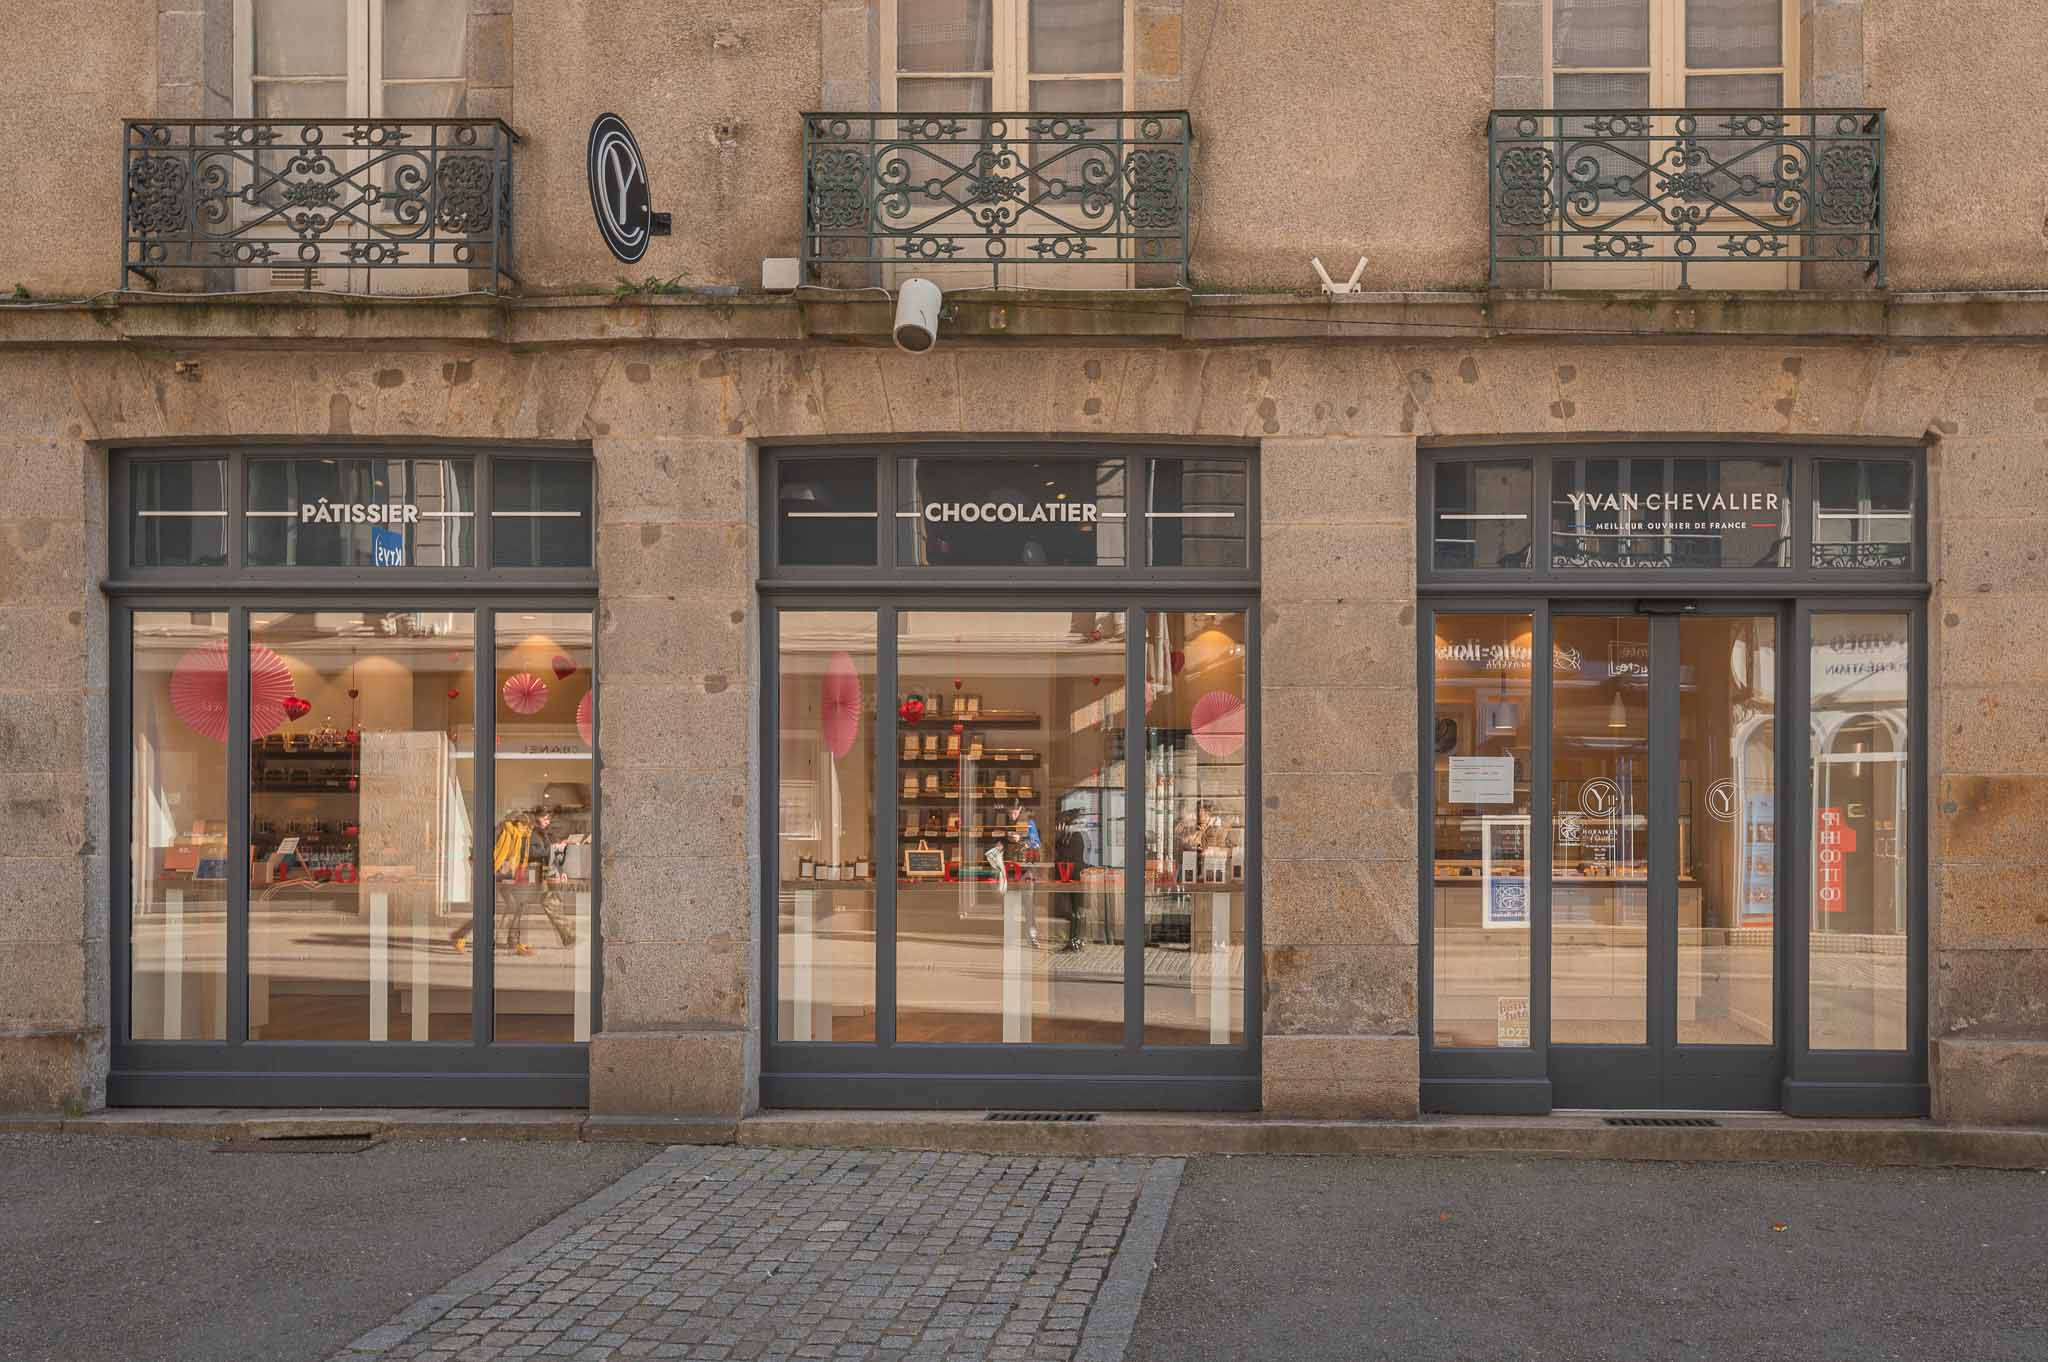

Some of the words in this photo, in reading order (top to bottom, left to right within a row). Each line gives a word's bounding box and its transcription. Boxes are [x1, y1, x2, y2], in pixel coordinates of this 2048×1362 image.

[301, 497, 420, 523] PÂTISSIER
[1567, 492, 1638, 511] YVAN
[1645, 493, 1780, 511] CHEVALIER
[924, 502, 1099, 523] CHOCOLATIER
[1595, 521, 1644, 531] MEILLEUR
[1647, 521, 1691, 530] OUVRIER
[1694, 521, 1707, 530] DE
[1709, 520, 1747, 530] FRANCE
